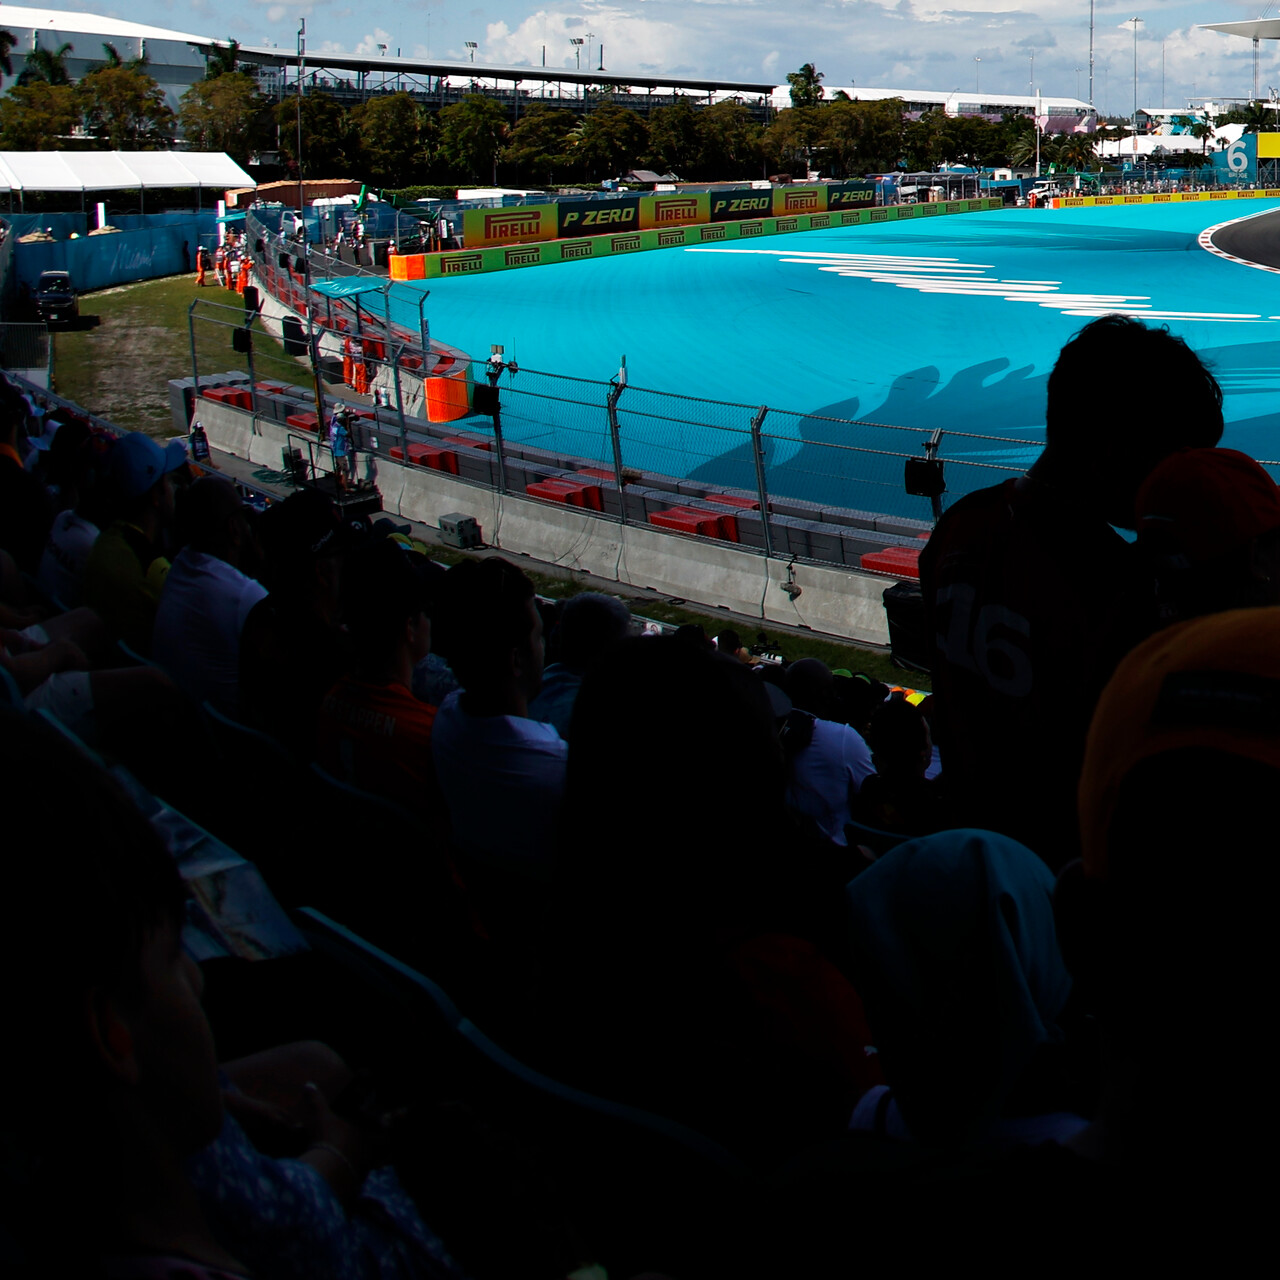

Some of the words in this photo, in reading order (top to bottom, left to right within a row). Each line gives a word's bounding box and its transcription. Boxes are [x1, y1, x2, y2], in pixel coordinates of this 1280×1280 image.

[1227, 141, 1248, 172] 6
[714, 200, 728, 214] P
[729, 197, 770, 212] ZERO
[784, 190, 818, 210] PIRELLI
[830, 192, 840, 204] P
[841, 190, 874, 202] ZERO
[563, 211, 579, 227] P
[581, 207, 636, 226] ZERO
[654, 198, 698, 222] PIRELLI
[842, 212, 860, 224] PIRELLI
[870, 209, 887, 221] PIRELLI
[484, 210, 542, 240] PIRELLI
[740, 222, 762, 235] PIRELLI
[776, 219, 797, 231] PIRELLI
[810, 214, 830, 228] PIRELLI
[658, 230, 684, 245] PIRELLI
[701, 226, 725, 240] PIRELLI
[561, 241, 592, 258] PIRELLI
[611, 235, 640, 251] PIRELLI
[441, 254, 482, 273] PIRELLI
[505, 248, 540, 265] PIRELLI
[935, 581, 1034, 697] 16
